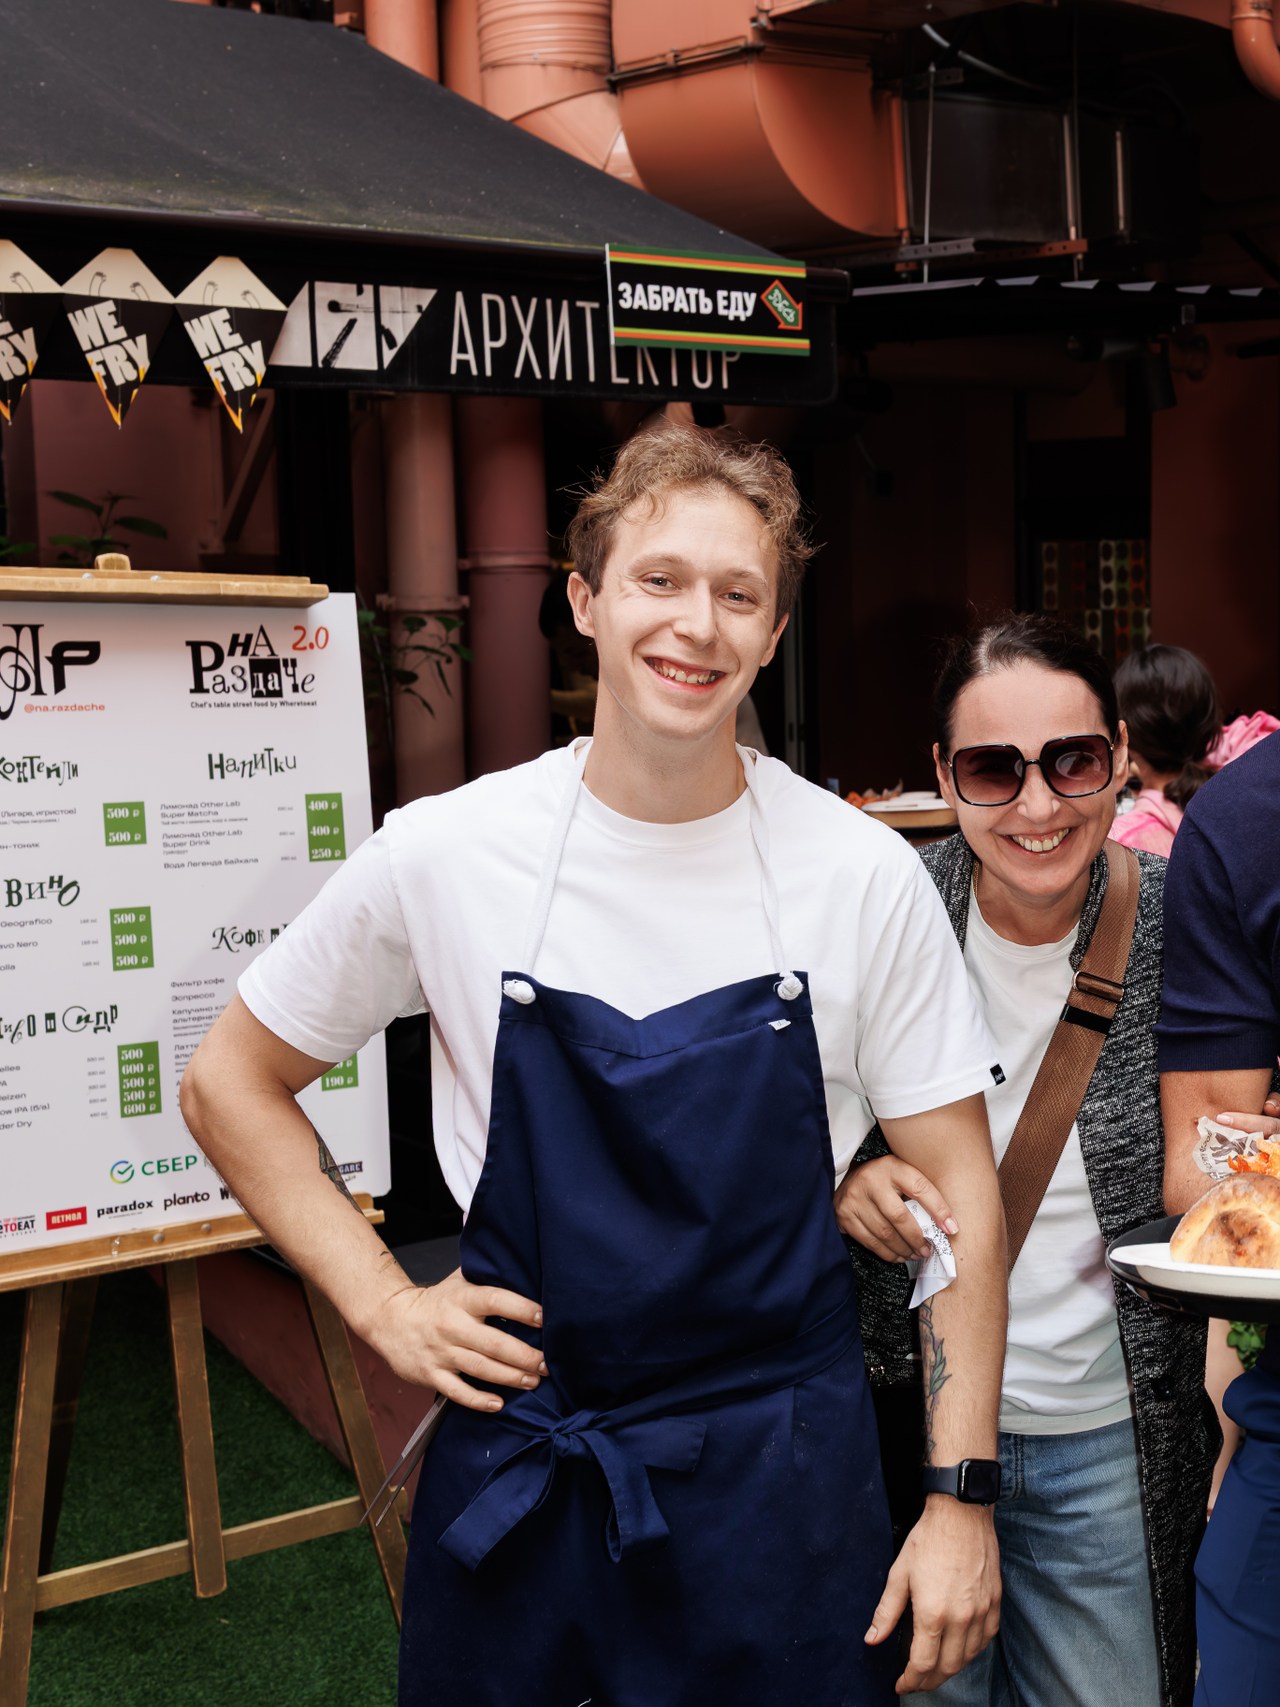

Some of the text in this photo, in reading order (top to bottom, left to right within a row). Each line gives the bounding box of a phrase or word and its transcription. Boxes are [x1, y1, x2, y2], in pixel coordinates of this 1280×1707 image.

[618, 281, 757, 322] ЗАБРАТЬ ЕДУ
[67, 299, 127, 352] WE
[184, 307, 244, 358] WE
[0, 327, 38, 382] RY
[85, 334, 150, 392] FRY
[203, 340, 267, 396] FRY
[291, 625, 330, 651] 2.0
[208, 748, 297, 780] Напитки
[107, 807, 129, 819] 500
[308, 800, 328, 811] 400
[108, 831, 131, 843] 500
[310, 825, 330, 836] 400
[312, 847, 332, 859] 250
[4, 875, 80, 907] Вино
[113, 912, 136, 925] 500
[114, 933, 137, 946] 500
[211, 925, 265, 953] Кофе
[116, 954, 138, 967] 500
[0, 1014, 36, 1044] иво
[121, 1048, 143, 1061] 500
[121, 1063, 144, 1075] 600
[122, 1077, 145, 1089] 500
[325, 1075, 345, 1088] 190
[123, 1090, 145, 1102] 500
[123, 1102, 146, 1115] 600
[141, 1154, 198, 1176] СБЕР
[97, 1198, 154, 1218] paradox
[163, 1191, 210, 1211] planto
